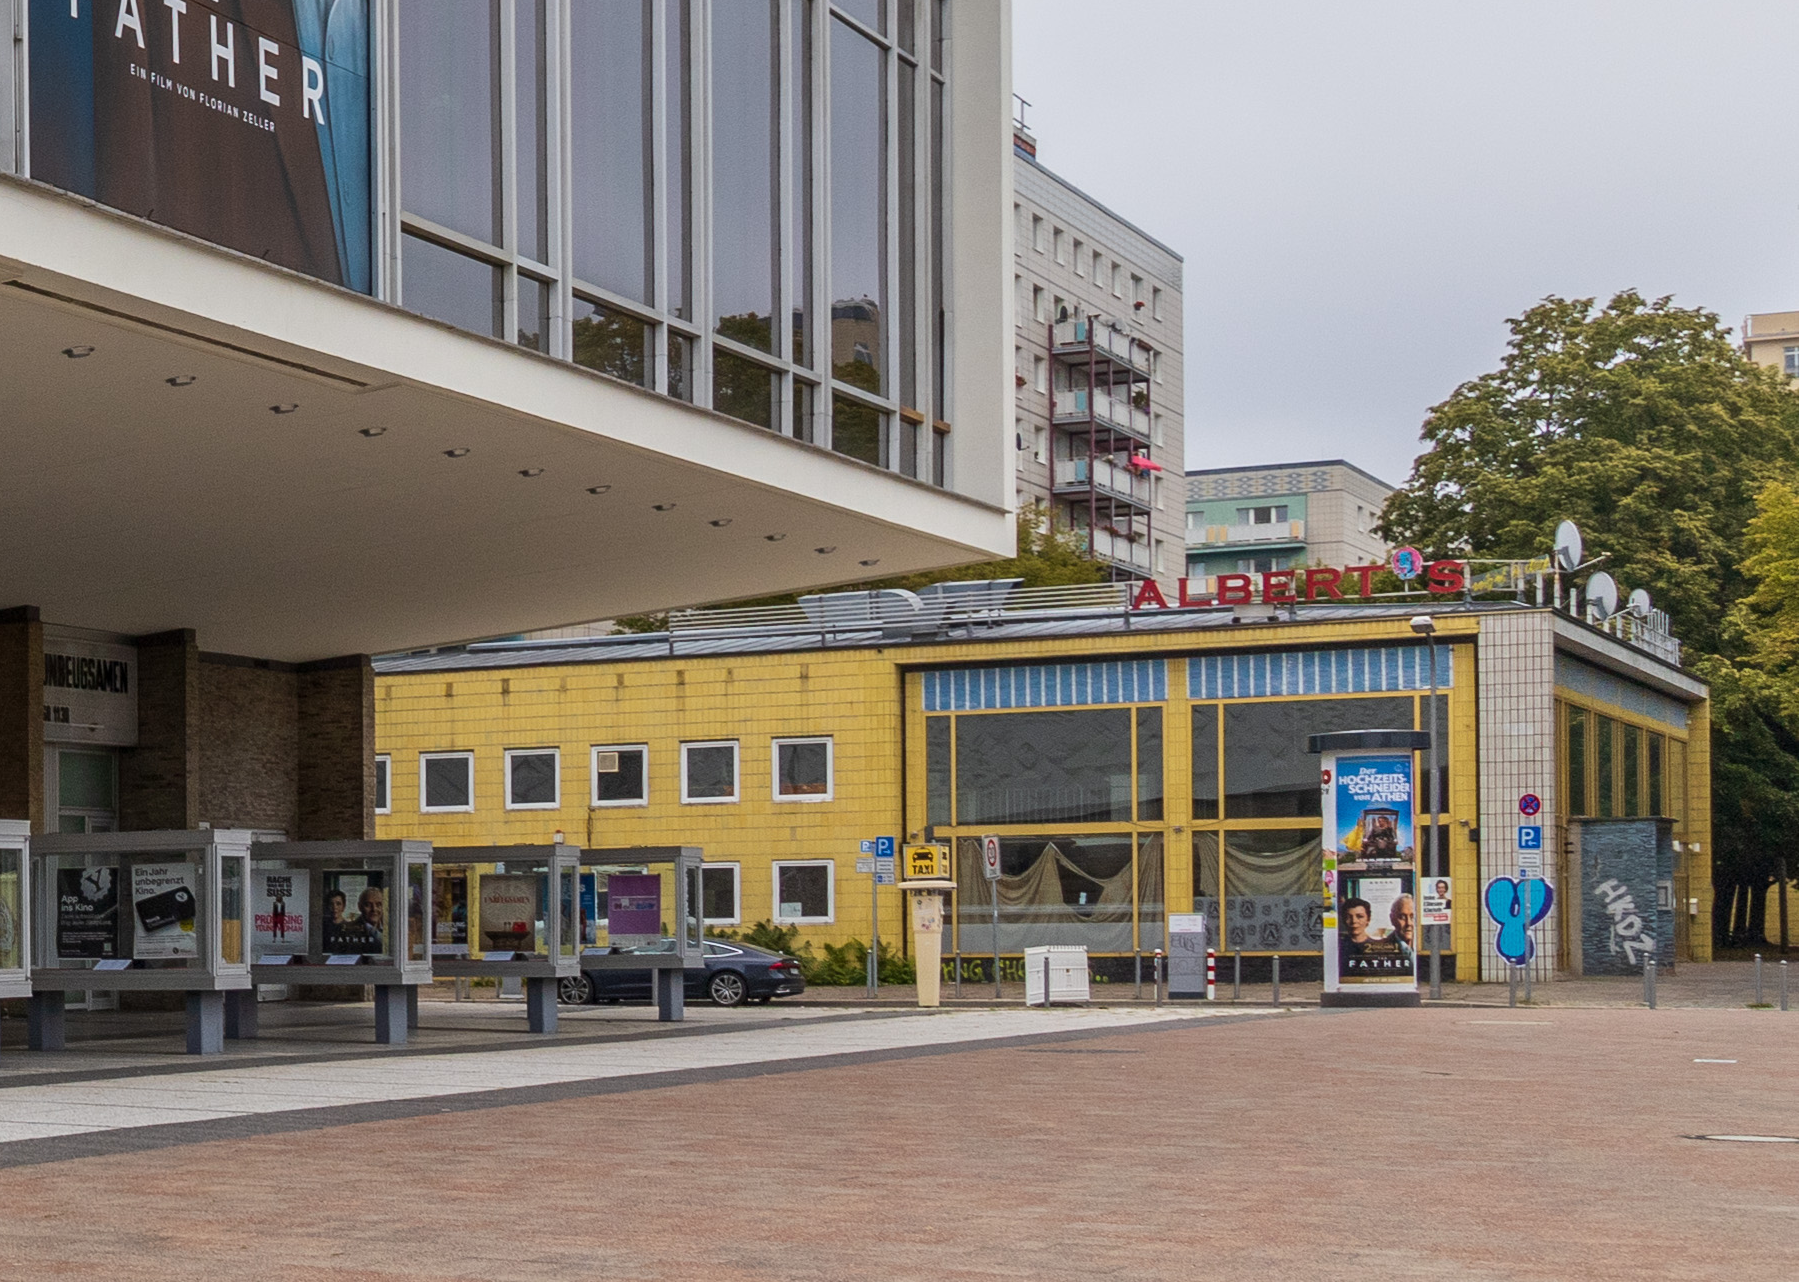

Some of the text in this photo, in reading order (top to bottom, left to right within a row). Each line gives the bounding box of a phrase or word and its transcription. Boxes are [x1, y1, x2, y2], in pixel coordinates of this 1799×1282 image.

[130, 63, 276, 133] EIN FILM VON FLORIAN ZELLER
[1359, 767, 1378, 775] Der
[1339, 774, 1408, 785] HOCHZEITS-
[1348, 783, 1410, 795] SCHNEIDER
[1371, 792, 1408, 802] ATHEN
[135, 867, 169, 876] Ein Jahr
[912, 864, 934, 875] TAXI
[135, 877, 184, 886] unbegrenzt
[135, 887, 161, 895] Kino.
[61, 894, 79, 904] App
[75, 903, 94, 912] Kino
[1348, 959, 1410, 968] FATHER
